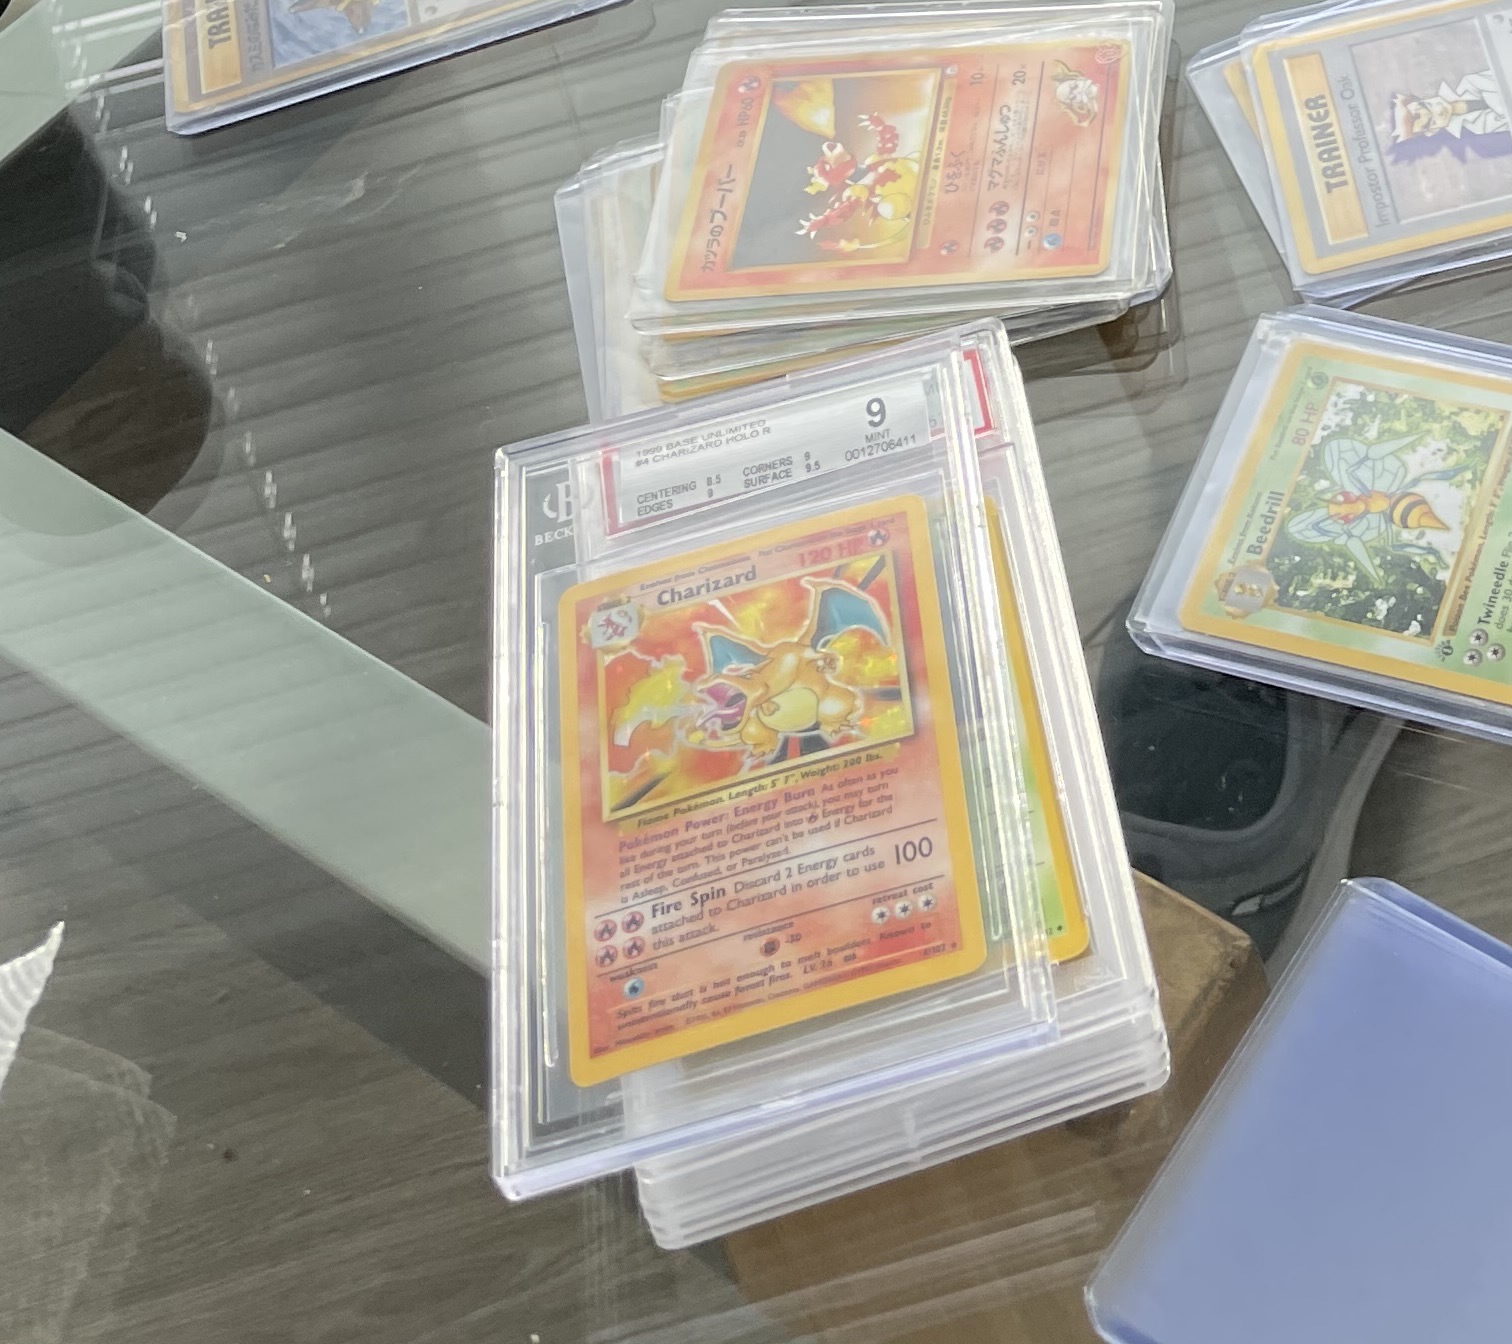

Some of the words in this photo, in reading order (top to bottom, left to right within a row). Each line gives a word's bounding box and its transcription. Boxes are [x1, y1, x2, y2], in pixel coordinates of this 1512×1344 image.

[1334, 73, 1356, 102] Oak
[1302, 92, 1350, 194] TRAINER
[1342, 100, 1375, 167] Professor
[1359, 163, 1393, 228] Impostor
[864, 395, 888, 430] 9
[1298, 400, 1321, 425] HP
[665, 435, 698, 451] BASE
[701, 417, 766, 441] UNLIMITED
[843, 432, 919, 463] 0012706411
[864, 427, 891, 444] MINT
[1289, 425, 1312, 447] 80
[741, 455, 793, 478] CORNERS
[743, 466, 793, 490] SURFACE
[804, 459, 821, 473] 9.5
[636, 479, 697, 505] CENTERING
[636, 497, 673, 517] EDGES
[533, 524, 574, 546] BECK
[1245, 489, 1286, 556] Beedrill
[654, 564, 757, 609] Charizard
[1476, 559, 1510, 626] Twineedle
[618, 824, 680, 853] Pokémon
[683, 808, 730, 833] Power:
[732, 794, 779, 820] Energy
[782, 783, 815, 804] Burn
[894, 833, 934, 866] 100
[649, 906, 705, 936] attached
[707, 904, 723, 918] to
[724, 882, 788, 914] Charizard
[788, 879, 804, 895] in
[805, 867, 843, 890] order
[845, 864, 860, 878] to
[862, 859, 885, 874] use
[650, 895, 683, 919] Fire
[689, 882, 726, 909] Spin
[733, 868, 782, 895] Discard
[784, 865, 793, 879] 2
[796, 851, 840, 879] Energy
[841, 843, 875, 864] cards
